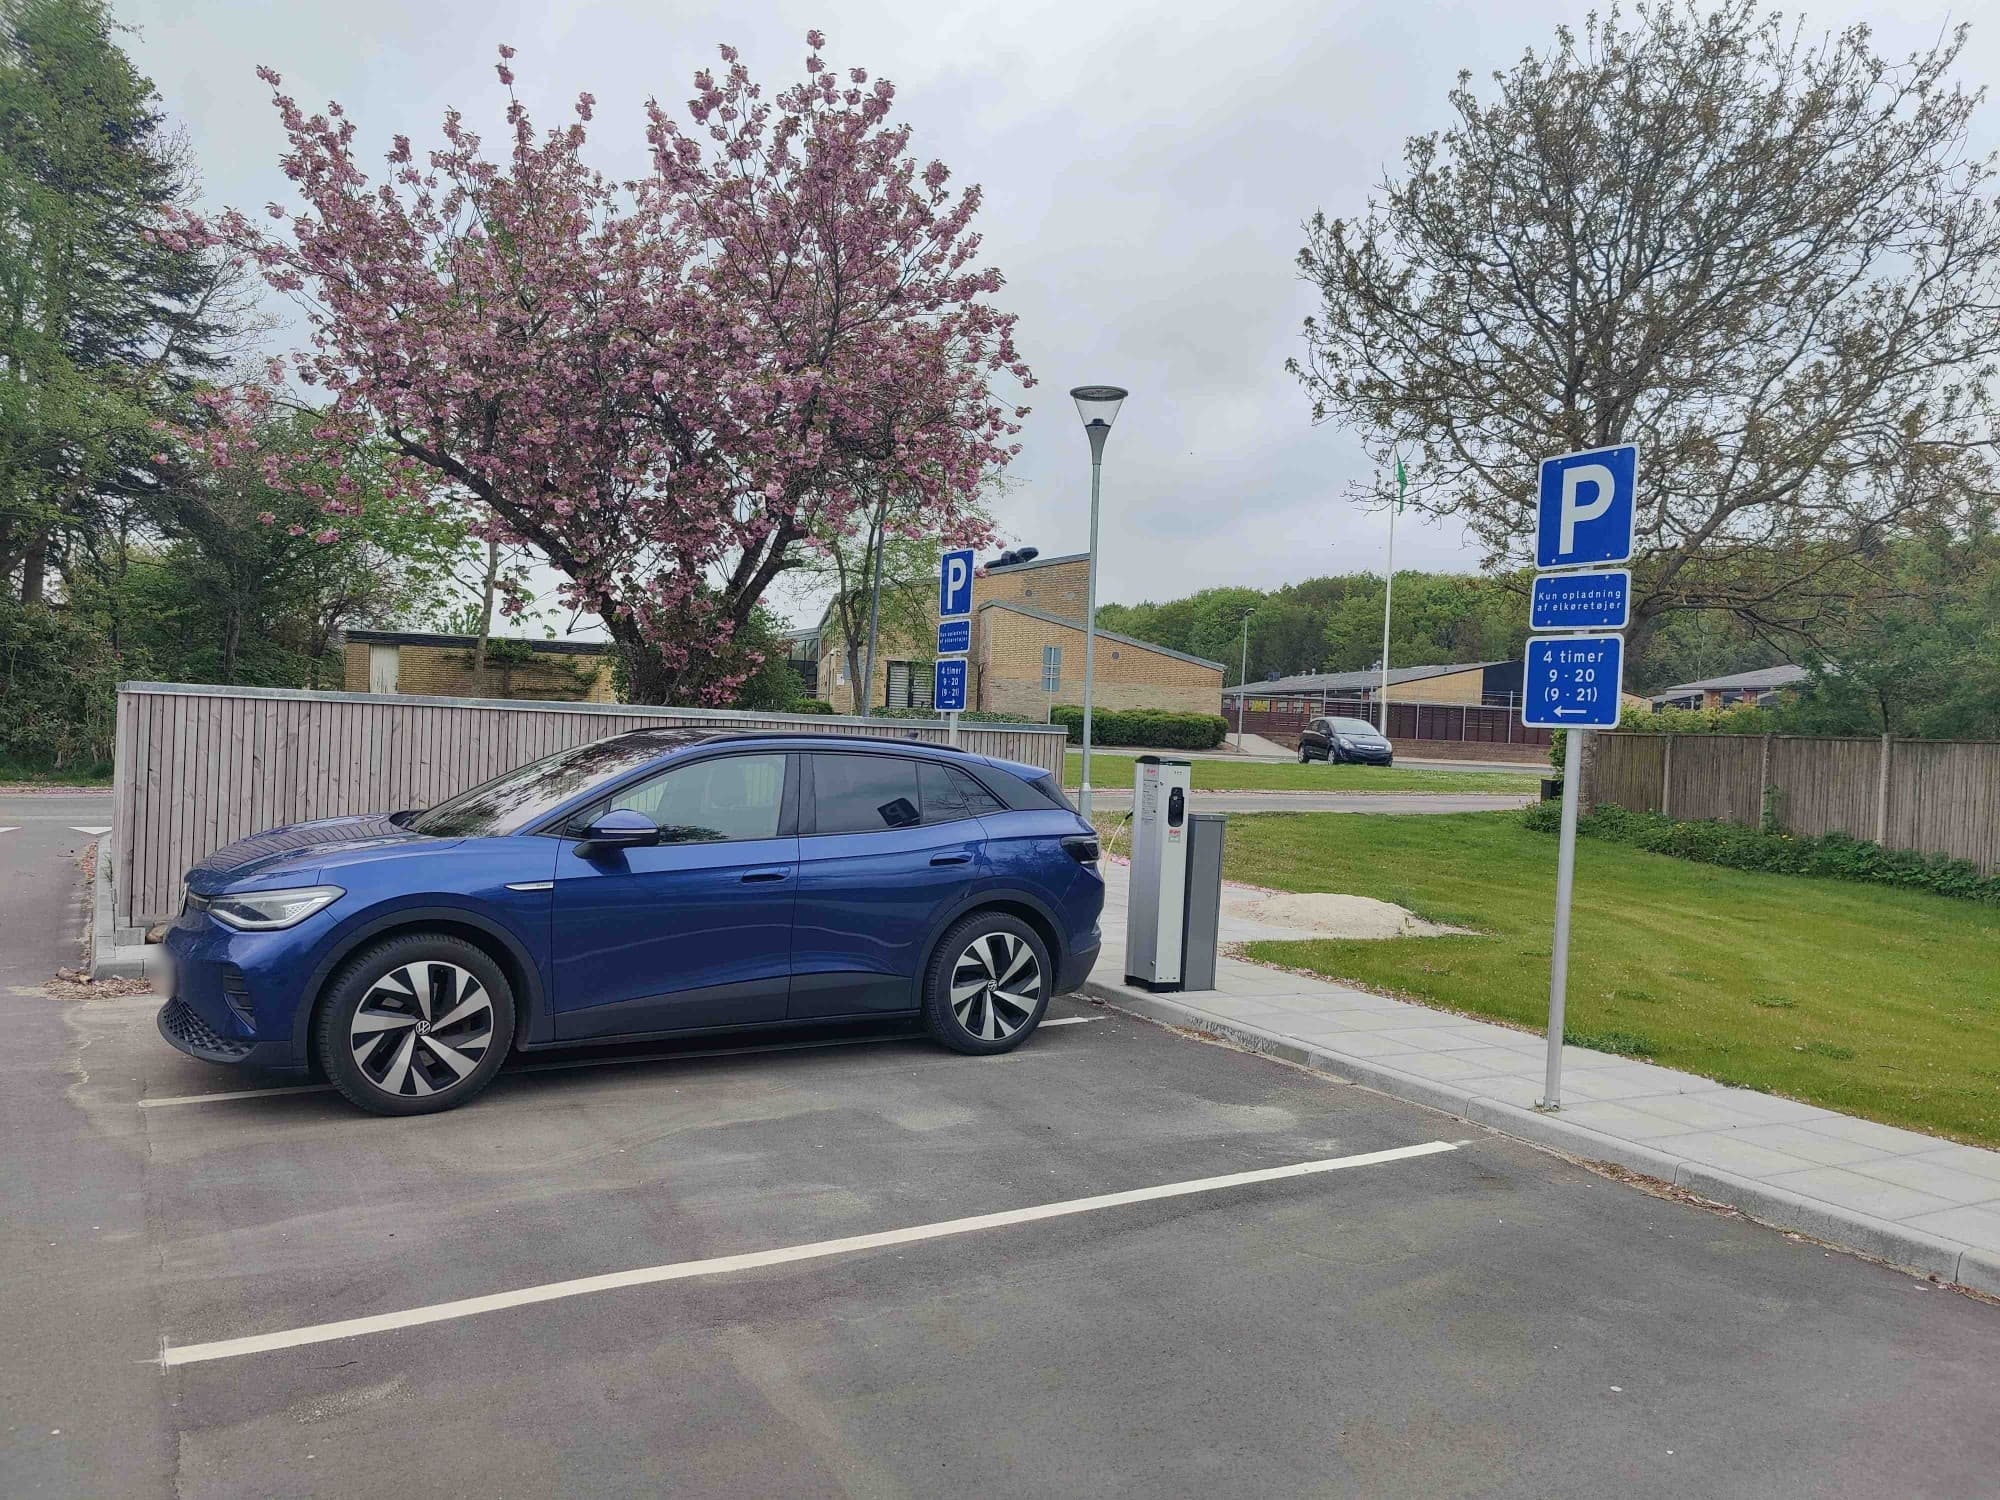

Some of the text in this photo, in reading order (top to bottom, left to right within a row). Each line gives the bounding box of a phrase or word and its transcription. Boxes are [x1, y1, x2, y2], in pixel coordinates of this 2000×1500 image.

[1559, 464, 1616, 555] P
[947, 558, 966, 609] P
[1538, 589, 1621, 600] Kun opladning
[1537, 601, 1621, 611] af elkøretøjer
[1543, 650, 1603, 663] 4 timer
[1549, 669, 1558, 682] 9
[1574, 668, 1595, 682] 20
[1544, 687, 1559, 702] (9
[1576, 687, 1598, 702] 21)
